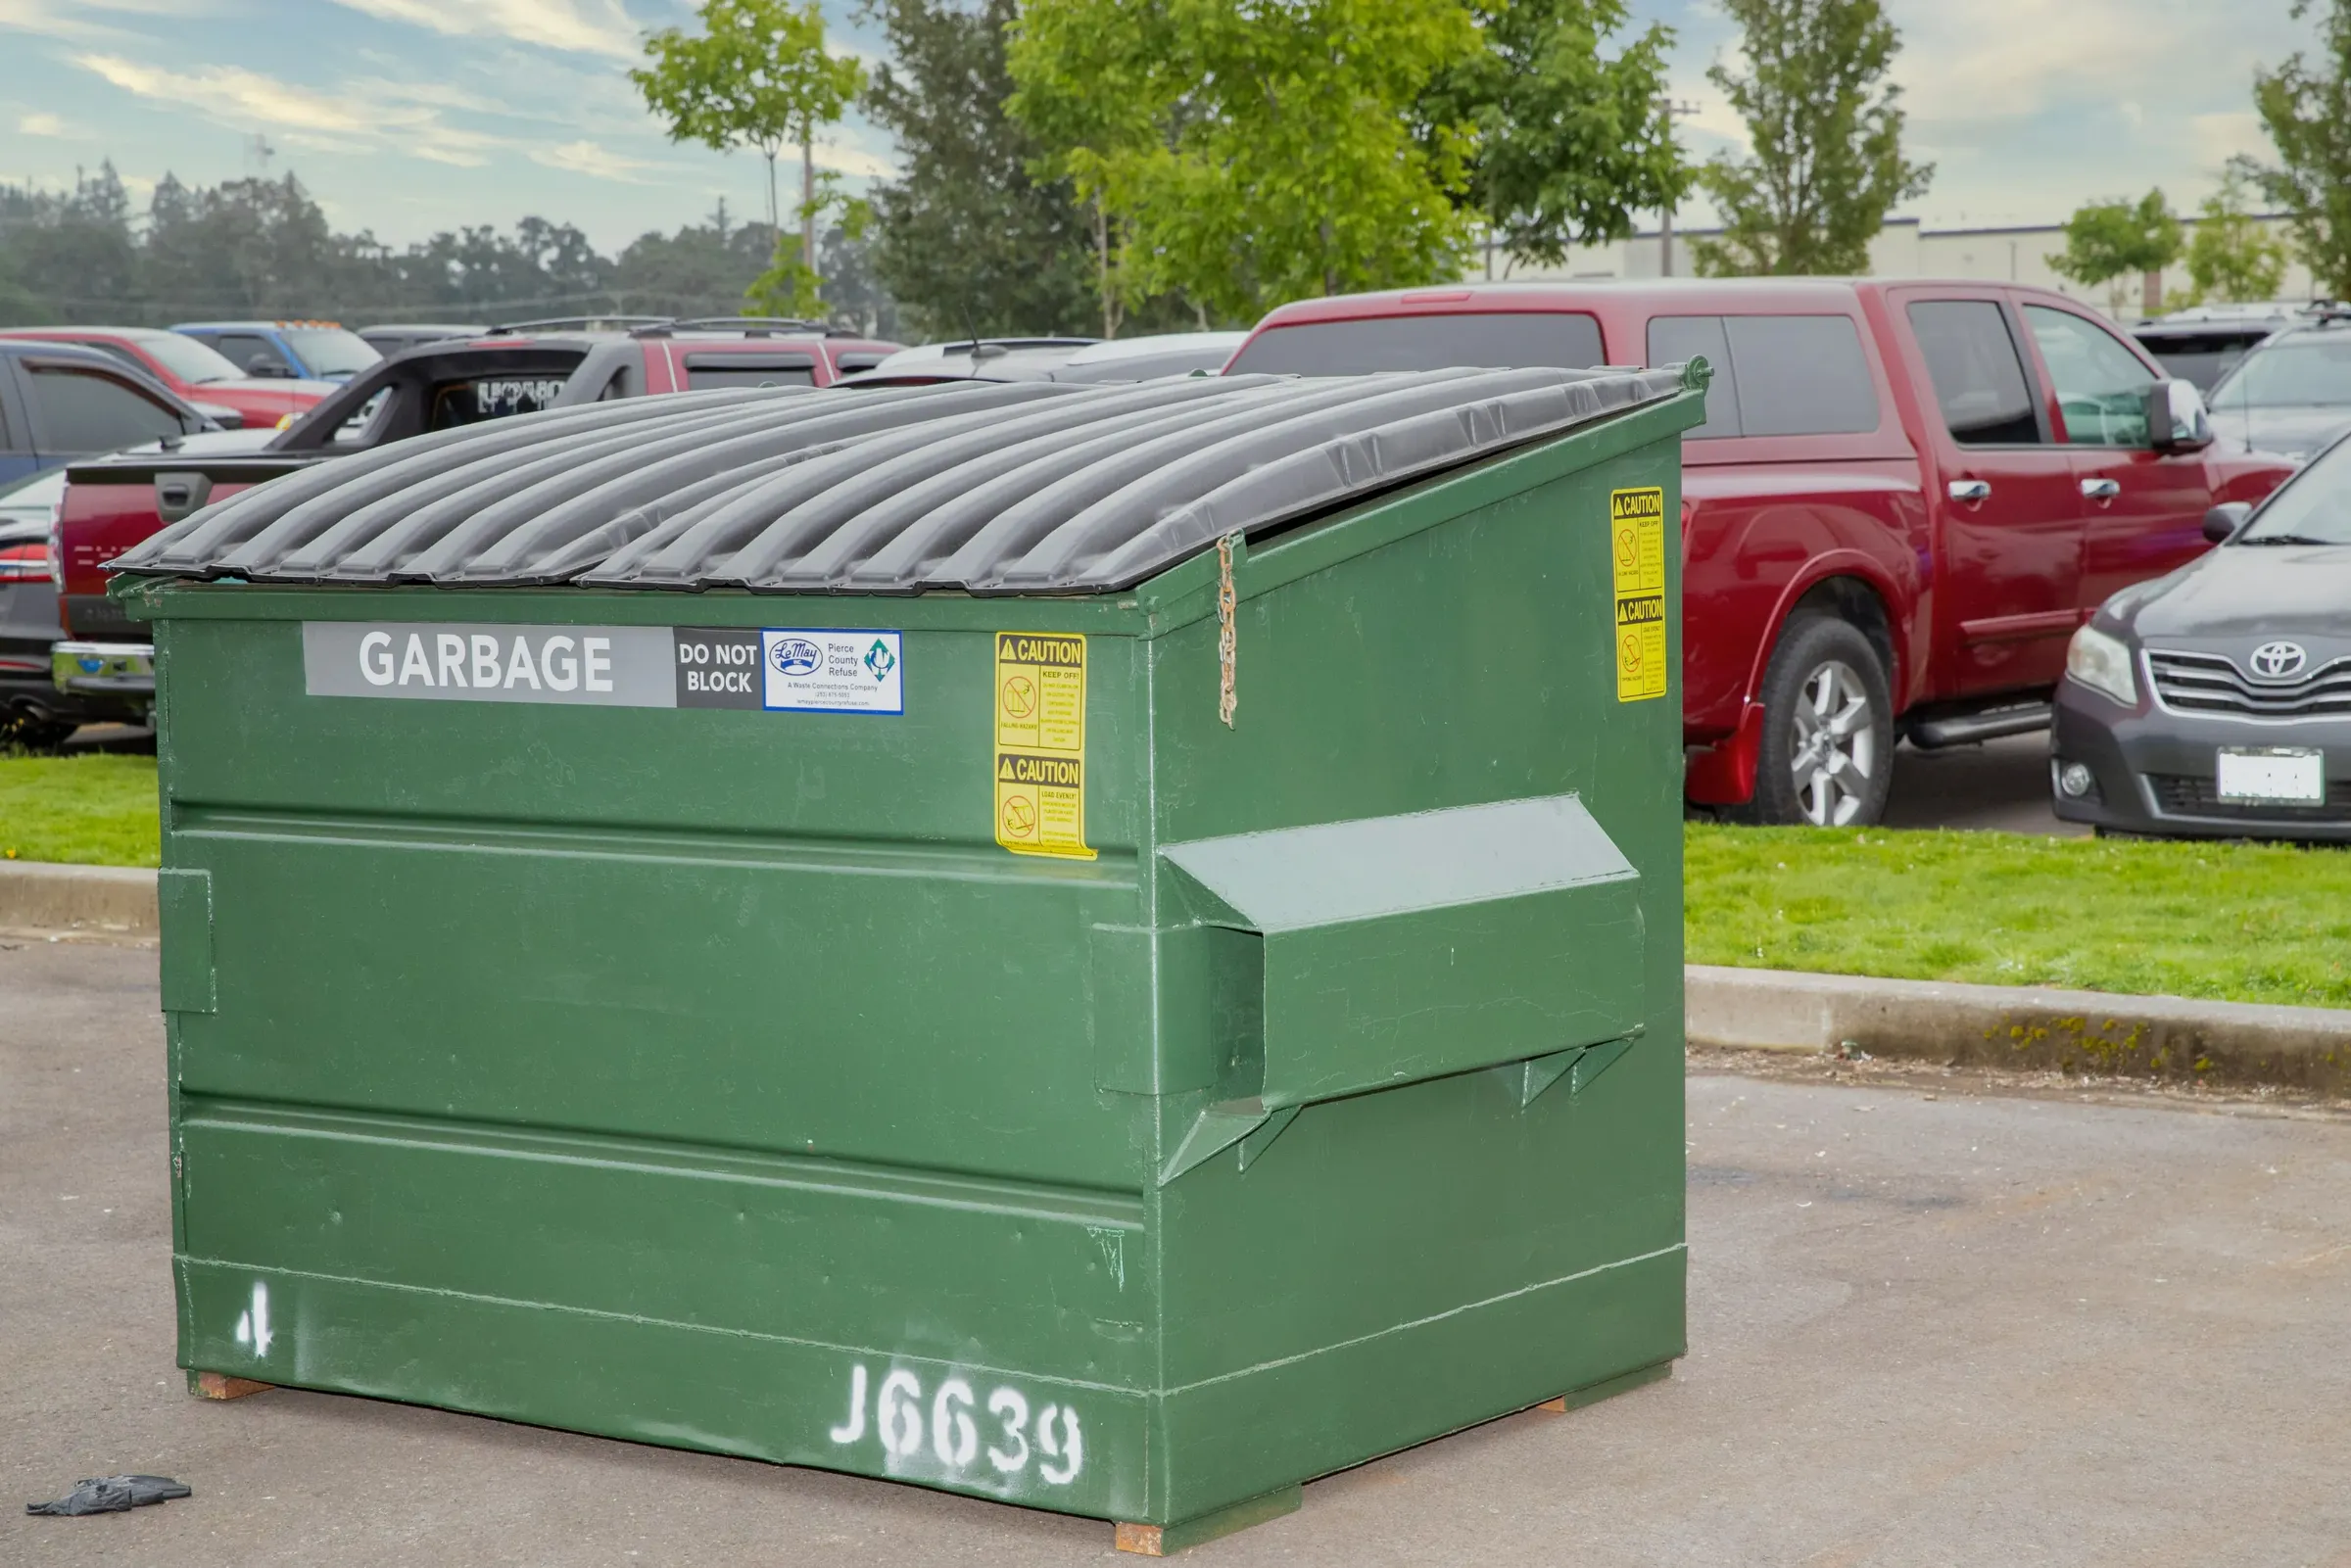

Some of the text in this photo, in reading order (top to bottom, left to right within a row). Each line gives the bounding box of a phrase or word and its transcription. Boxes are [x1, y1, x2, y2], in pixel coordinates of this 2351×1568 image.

[1624, 495, 1660, 515] CAUTION
[1628, 599, 1662, 620] CAUTION
[679, 643, 757, 665] DO NOT
[828, 642, 854, 653] Pierce
[1018, 639, 1081, 664] CAUTION
[359, 631, 613, 691] GARBAGE
[828, 655, 858, 667] County
[688, 671, 752, 692] BLOCK
[829, 668, 857, 677] Refuse
[1017, 758, 1079, 784] CAUTION
[830, 1364, 1082, 1486] J6639
